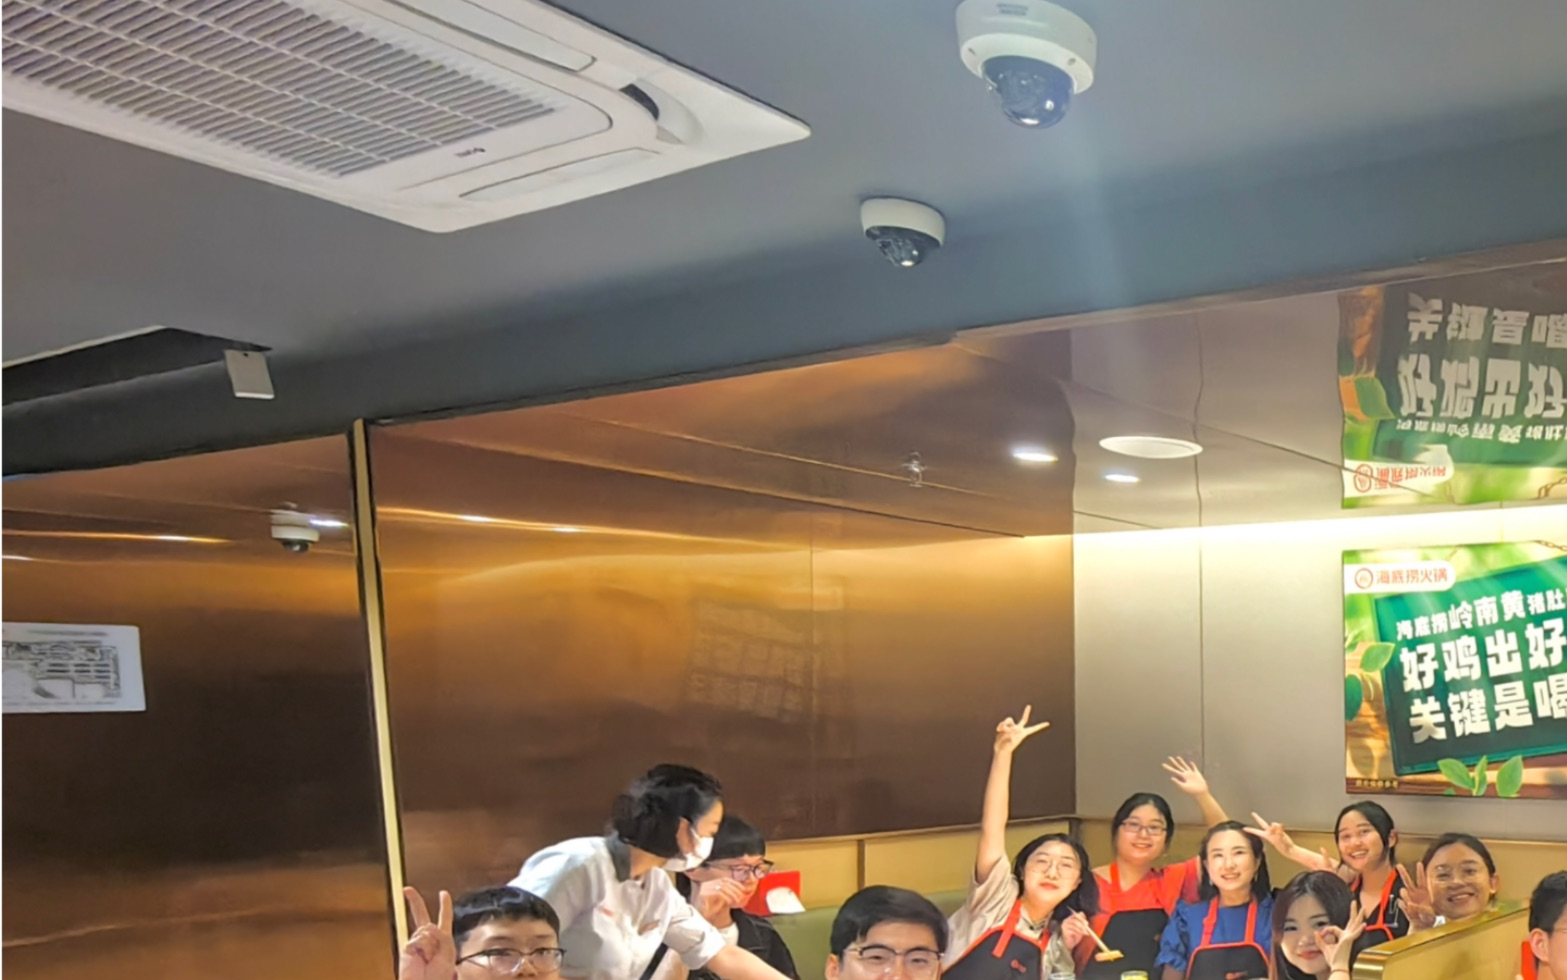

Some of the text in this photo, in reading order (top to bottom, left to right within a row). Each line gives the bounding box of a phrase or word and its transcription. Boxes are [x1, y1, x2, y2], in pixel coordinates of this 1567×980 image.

[1375, 567, 1448, 585] 海底捞火锅
